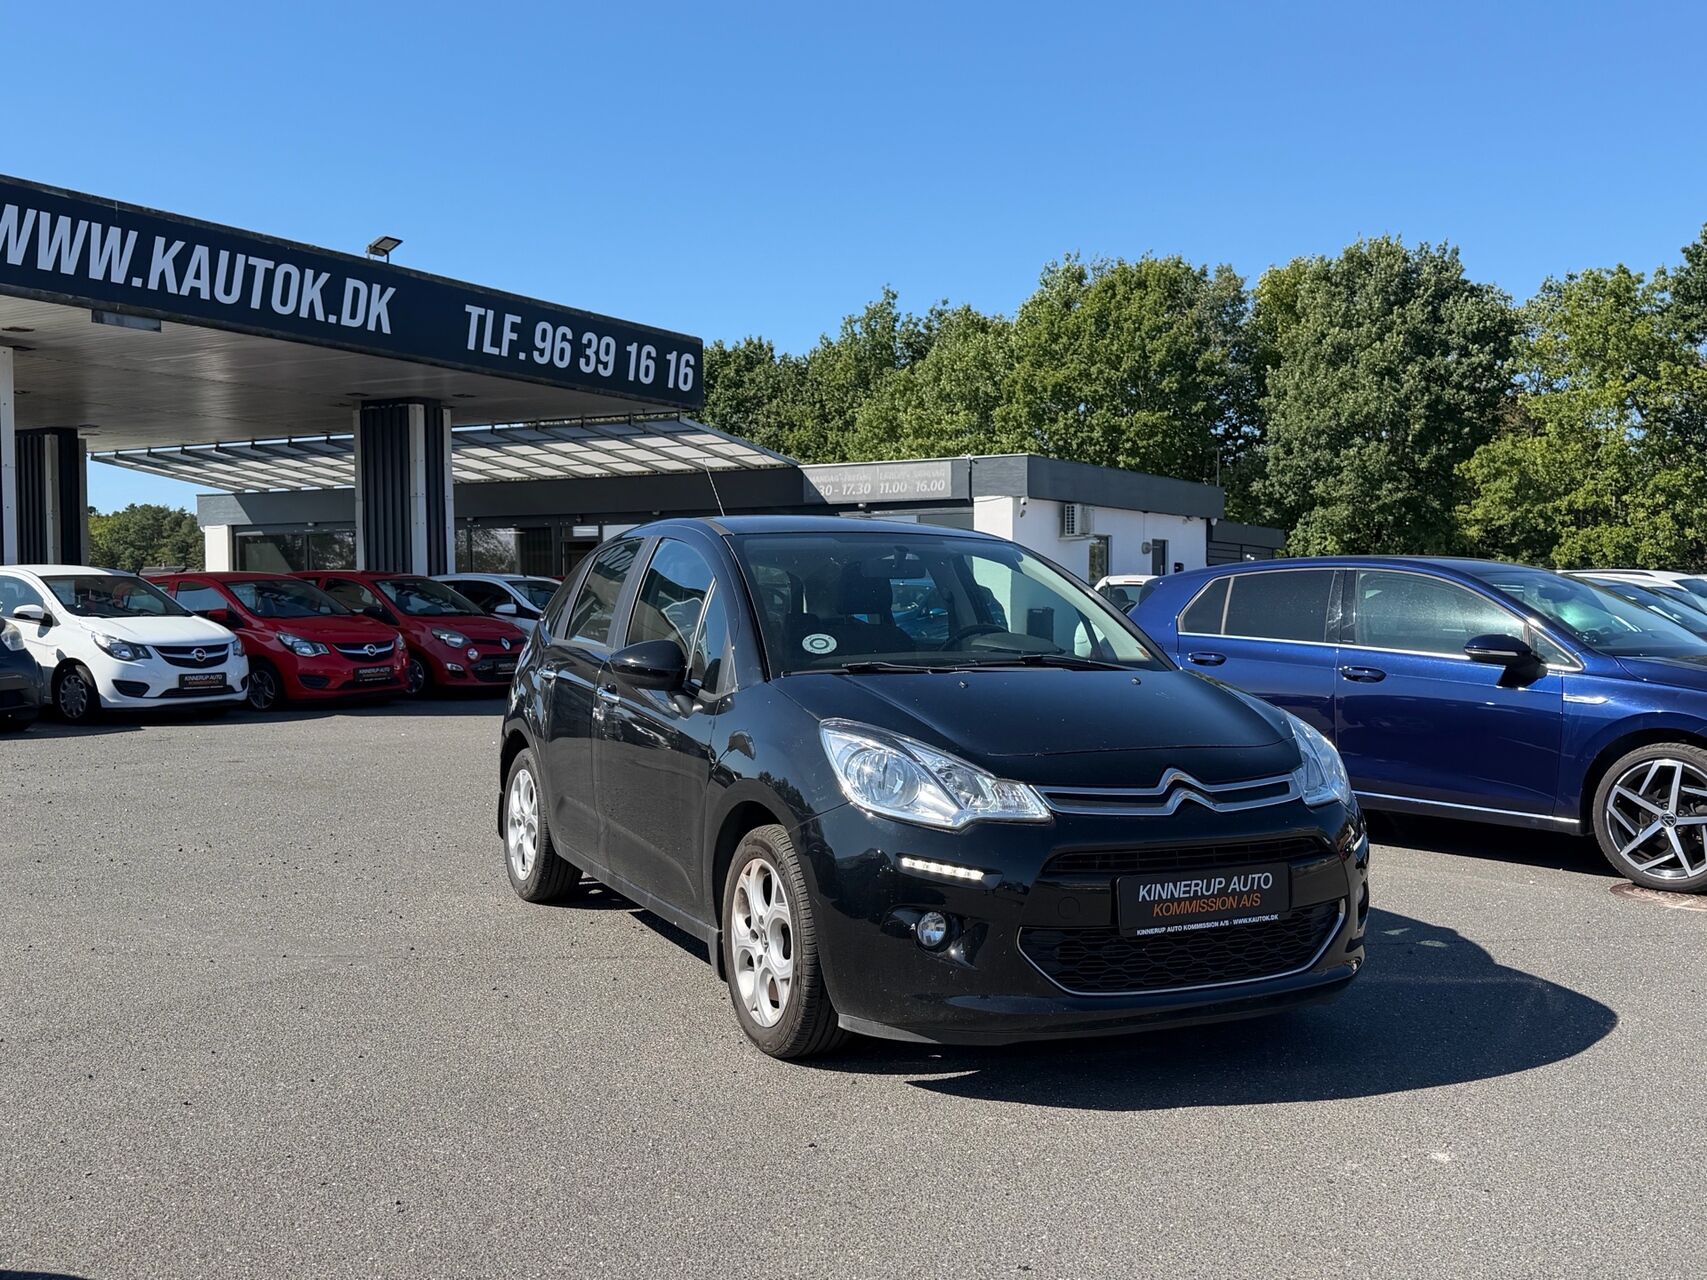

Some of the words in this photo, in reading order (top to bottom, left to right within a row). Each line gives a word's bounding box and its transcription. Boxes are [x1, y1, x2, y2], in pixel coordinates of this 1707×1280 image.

[0, 203, 397, 335] WWW.KAUTOK.DK
[465, 304, 526, 361] TLF.
[532, 321, 573, 369] 96
[579, 332, 617, 378] 39
[626, 342, 657, 385] 16
[666, 350, 695, 392] 16
[842, 482, 871, 496] 17.30
[880, 481, 907, 494] 11.00
[915, 479, 945, 492] 16.00
[1138, 877, 1225, 902] KINNERUP
[1228, 872, 1273, 893] AUTO
[1153, 895, 1238, 917] KOMMISSION
[1240, 893, 1261, 907] A/S
[1136, 926, 1166, 936] KINNERUP
[1167, 924, 1182, 933] AUTO
[1183, 921, 1219, 931] KOMMISSION
[1233, 913, 1279, 925] WWW.KAUTOK.DK
